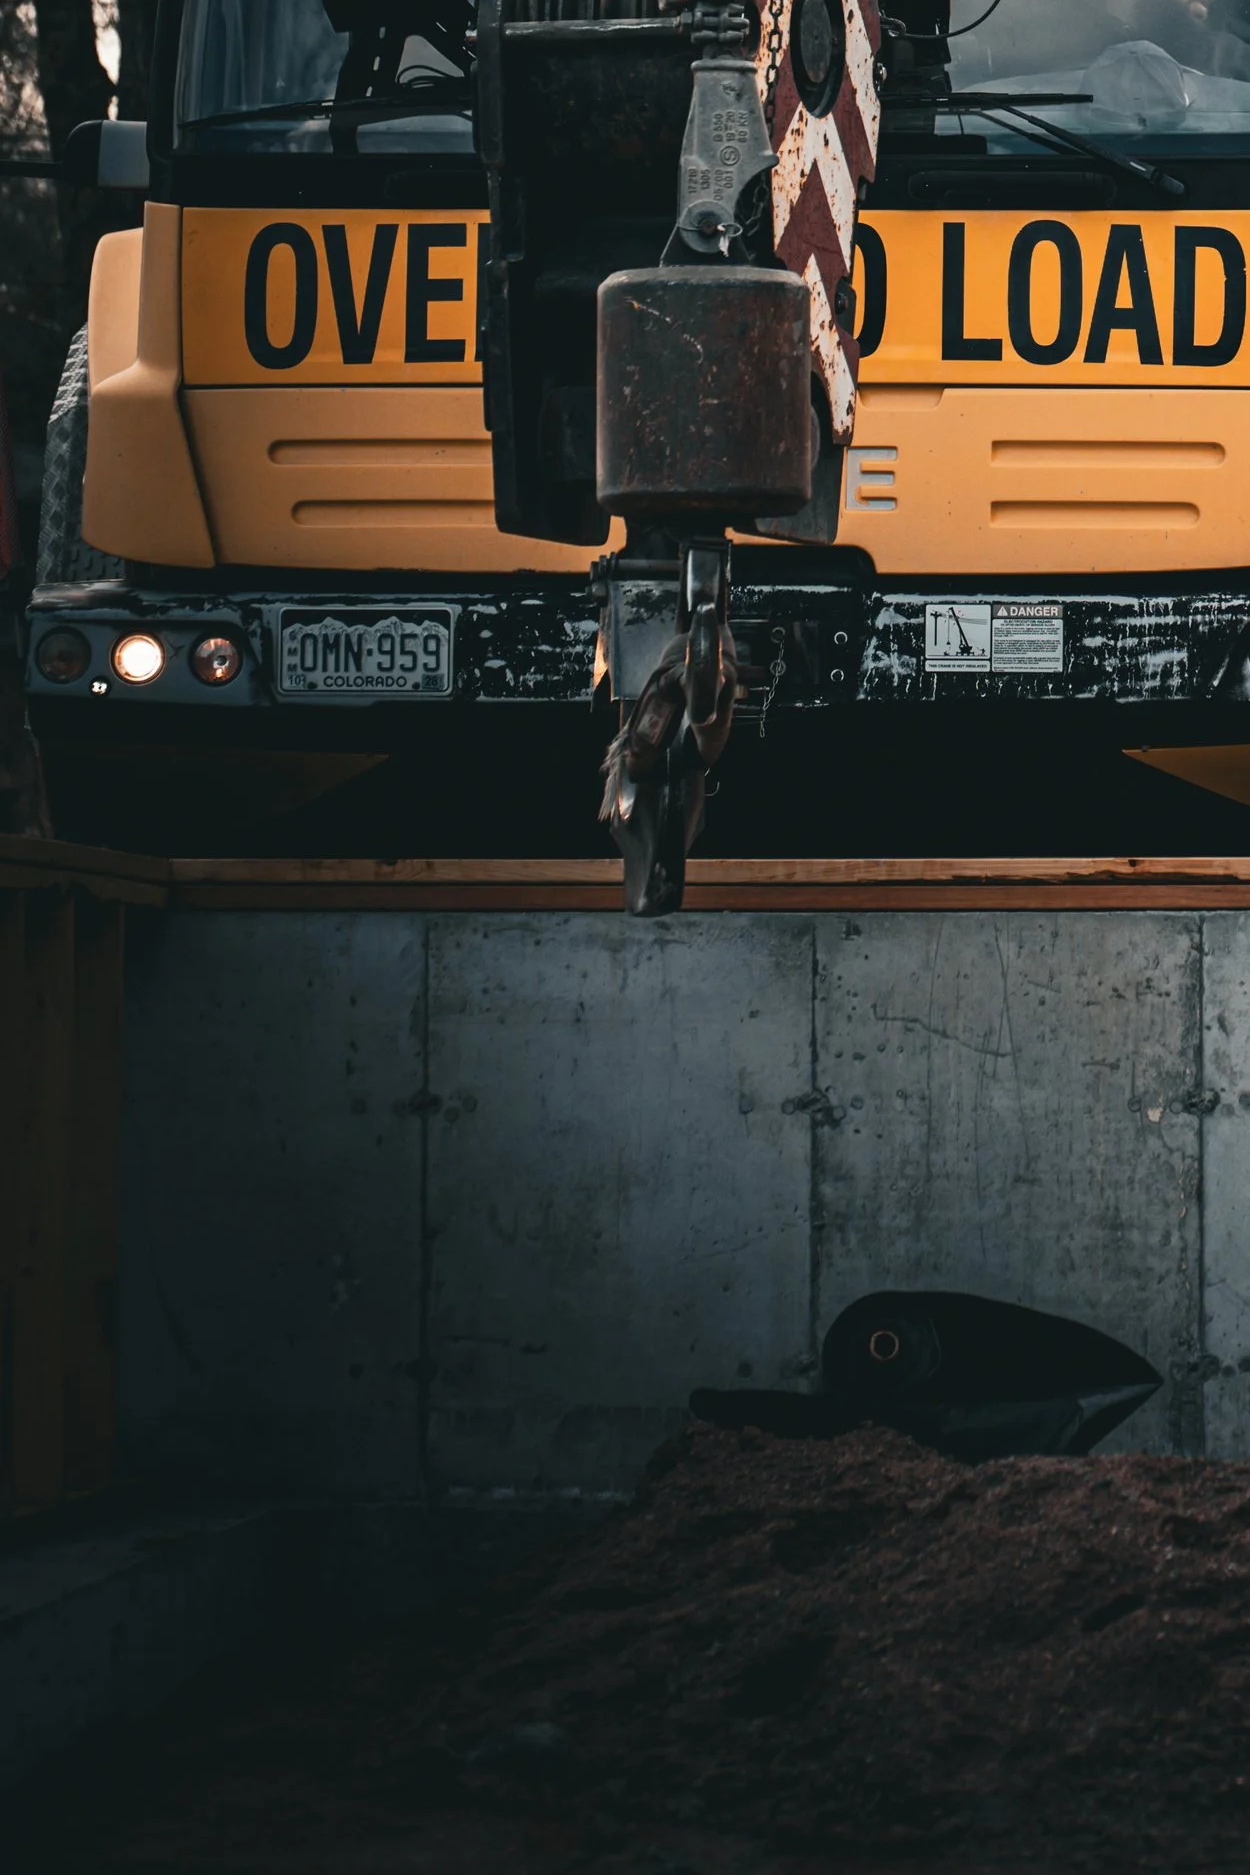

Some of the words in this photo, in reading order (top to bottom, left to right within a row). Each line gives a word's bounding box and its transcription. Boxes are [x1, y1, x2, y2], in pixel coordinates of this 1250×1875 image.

[244, 222, 488, 370] OVE
[941, 219, 1247, 367] LOAD
[1010, 606, 1059, 617] DANGER
[322, 675, 408, 688] COLORADO
